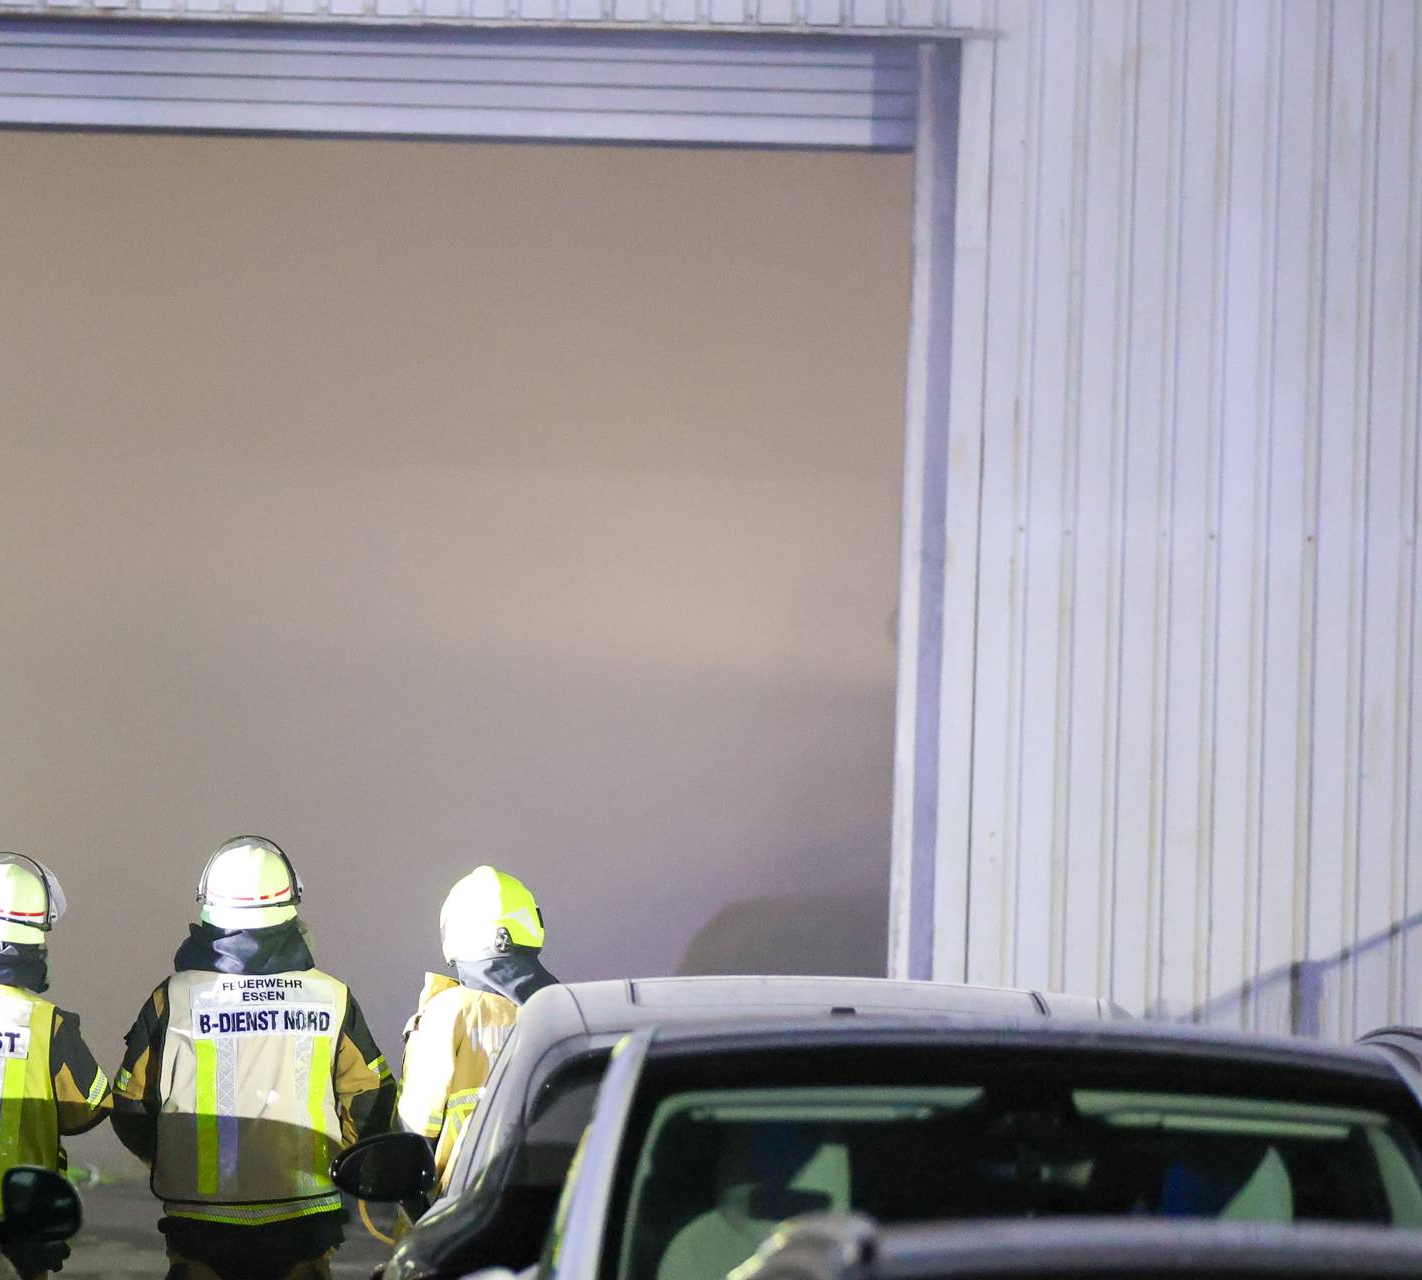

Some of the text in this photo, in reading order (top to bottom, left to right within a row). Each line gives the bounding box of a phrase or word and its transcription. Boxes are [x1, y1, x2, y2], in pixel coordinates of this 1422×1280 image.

[222, 979, 303, 991] FEUERWEHR
[242, 991, 285, 1002] ESSEN
[199, 1009, 330, 1034] B-DIENST NORD
